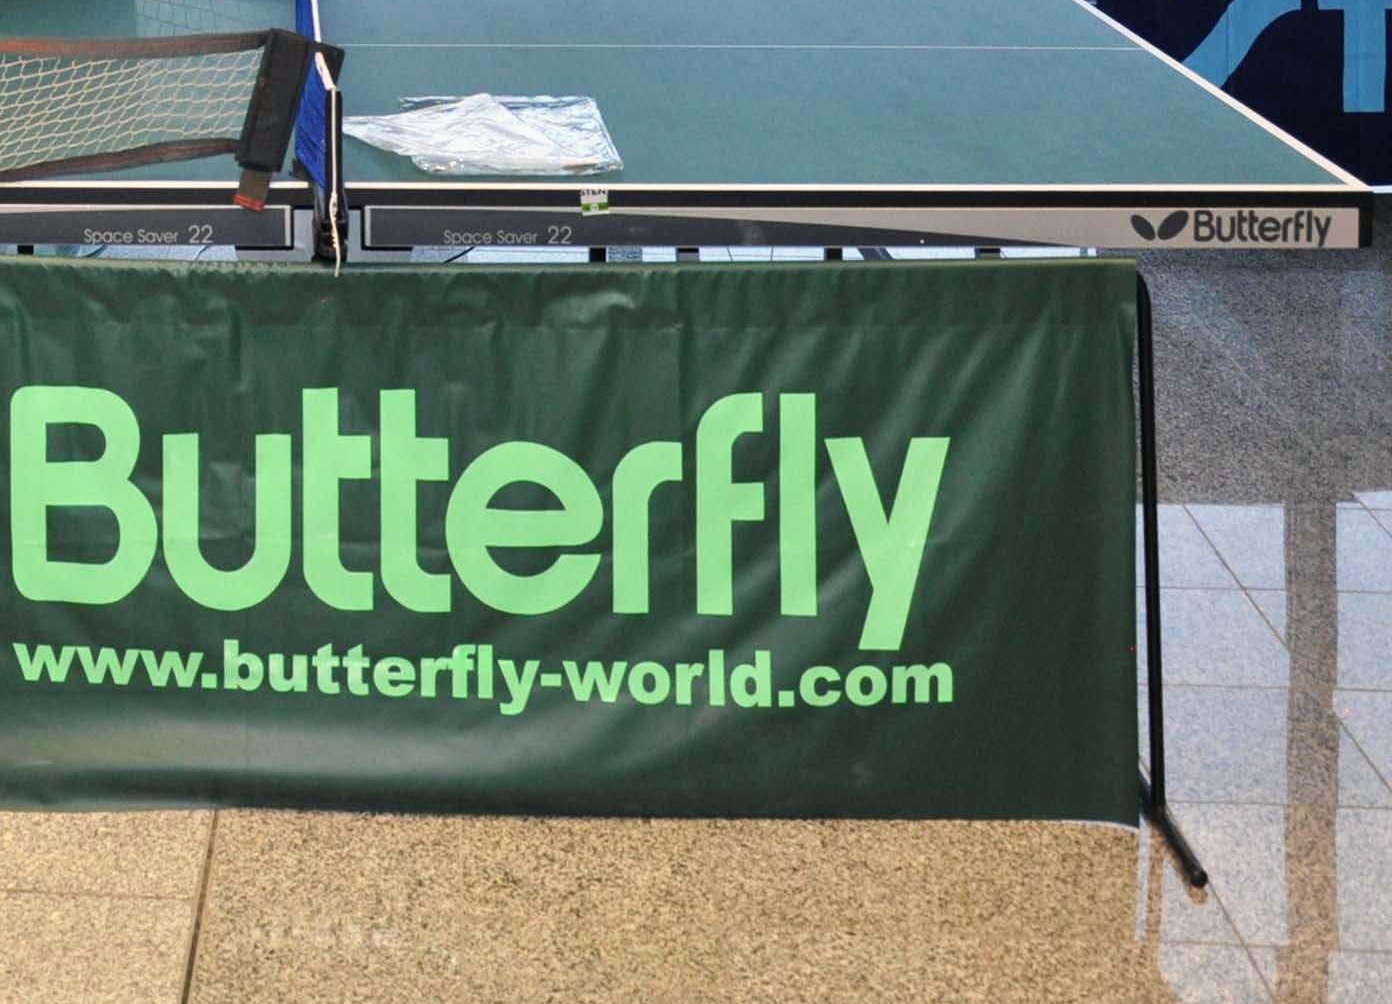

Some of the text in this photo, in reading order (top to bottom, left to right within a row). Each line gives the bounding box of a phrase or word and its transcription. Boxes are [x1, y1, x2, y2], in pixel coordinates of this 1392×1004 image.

[83, 224, 214, 246] Space Saver 22
[443, 225, 573, 246] Space Saver 22
[1193, 209, 1332, 247] Butterfly
[10, 385, 951, 651] Butterfly
[13, 639, 954, 716] www.butterfly-world.com
